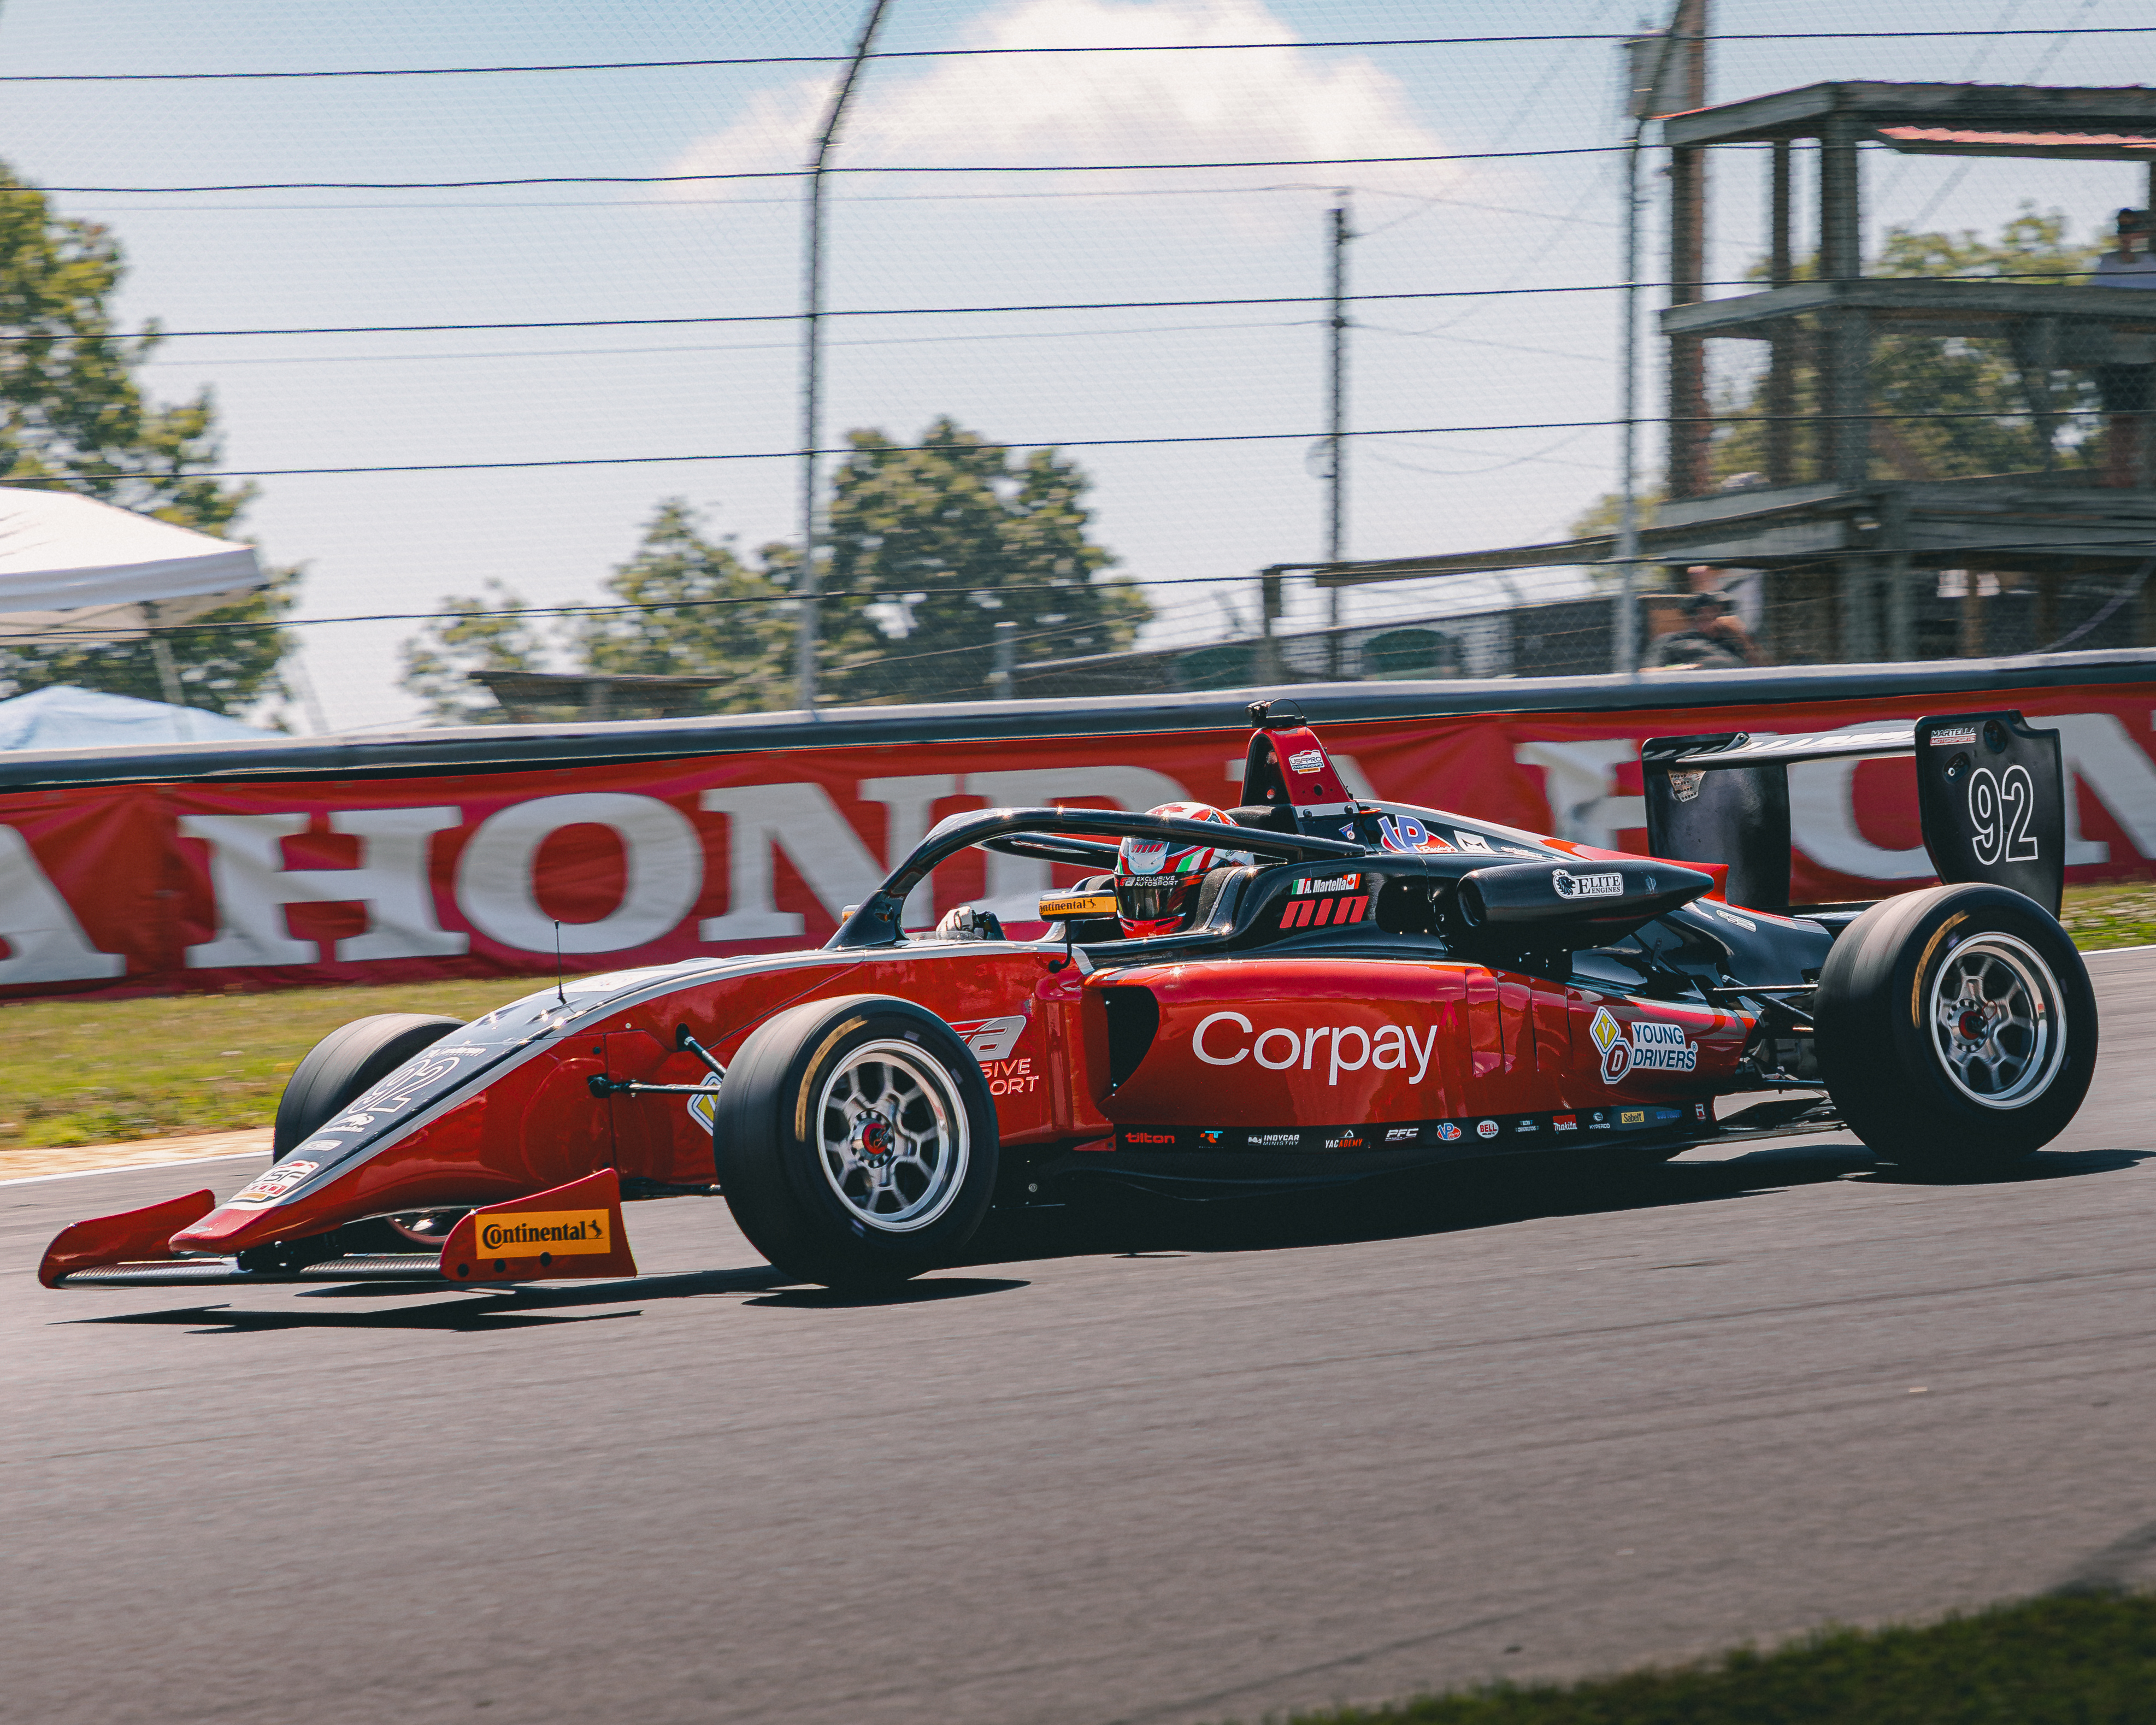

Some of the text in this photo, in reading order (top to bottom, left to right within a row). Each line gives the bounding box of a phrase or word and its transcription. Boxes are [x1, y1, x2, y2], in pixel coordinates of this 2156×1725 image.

[1931, 727, 1975, 738] MARTELLA
[1969, 765, 2038, 865] 92
[178, 755, 1377, 969] HOND
[1304, 878, 1347, 893] A. Martella
[1577, 876, 1621, 894] ELITE
[1633, 1024, 1684, 1045] YOUNG
[1193, 1011, 1438, 1086] Corpay
[1633, 1049, 1695, 1069] DRIVERS
[347, 1056, 460, 1114] 92
[1623, 1113, 1642, 1122] Sabelt
[1386, 1128, 1419, 1138] PFC
[1480, 1123, 1498, 1132] BELL
[1126, 1132, 1175, 1143] tilton
[1326, 1139, 1363, 1148] YACADEMY
[482, 1221, 587, 1250] Continental
